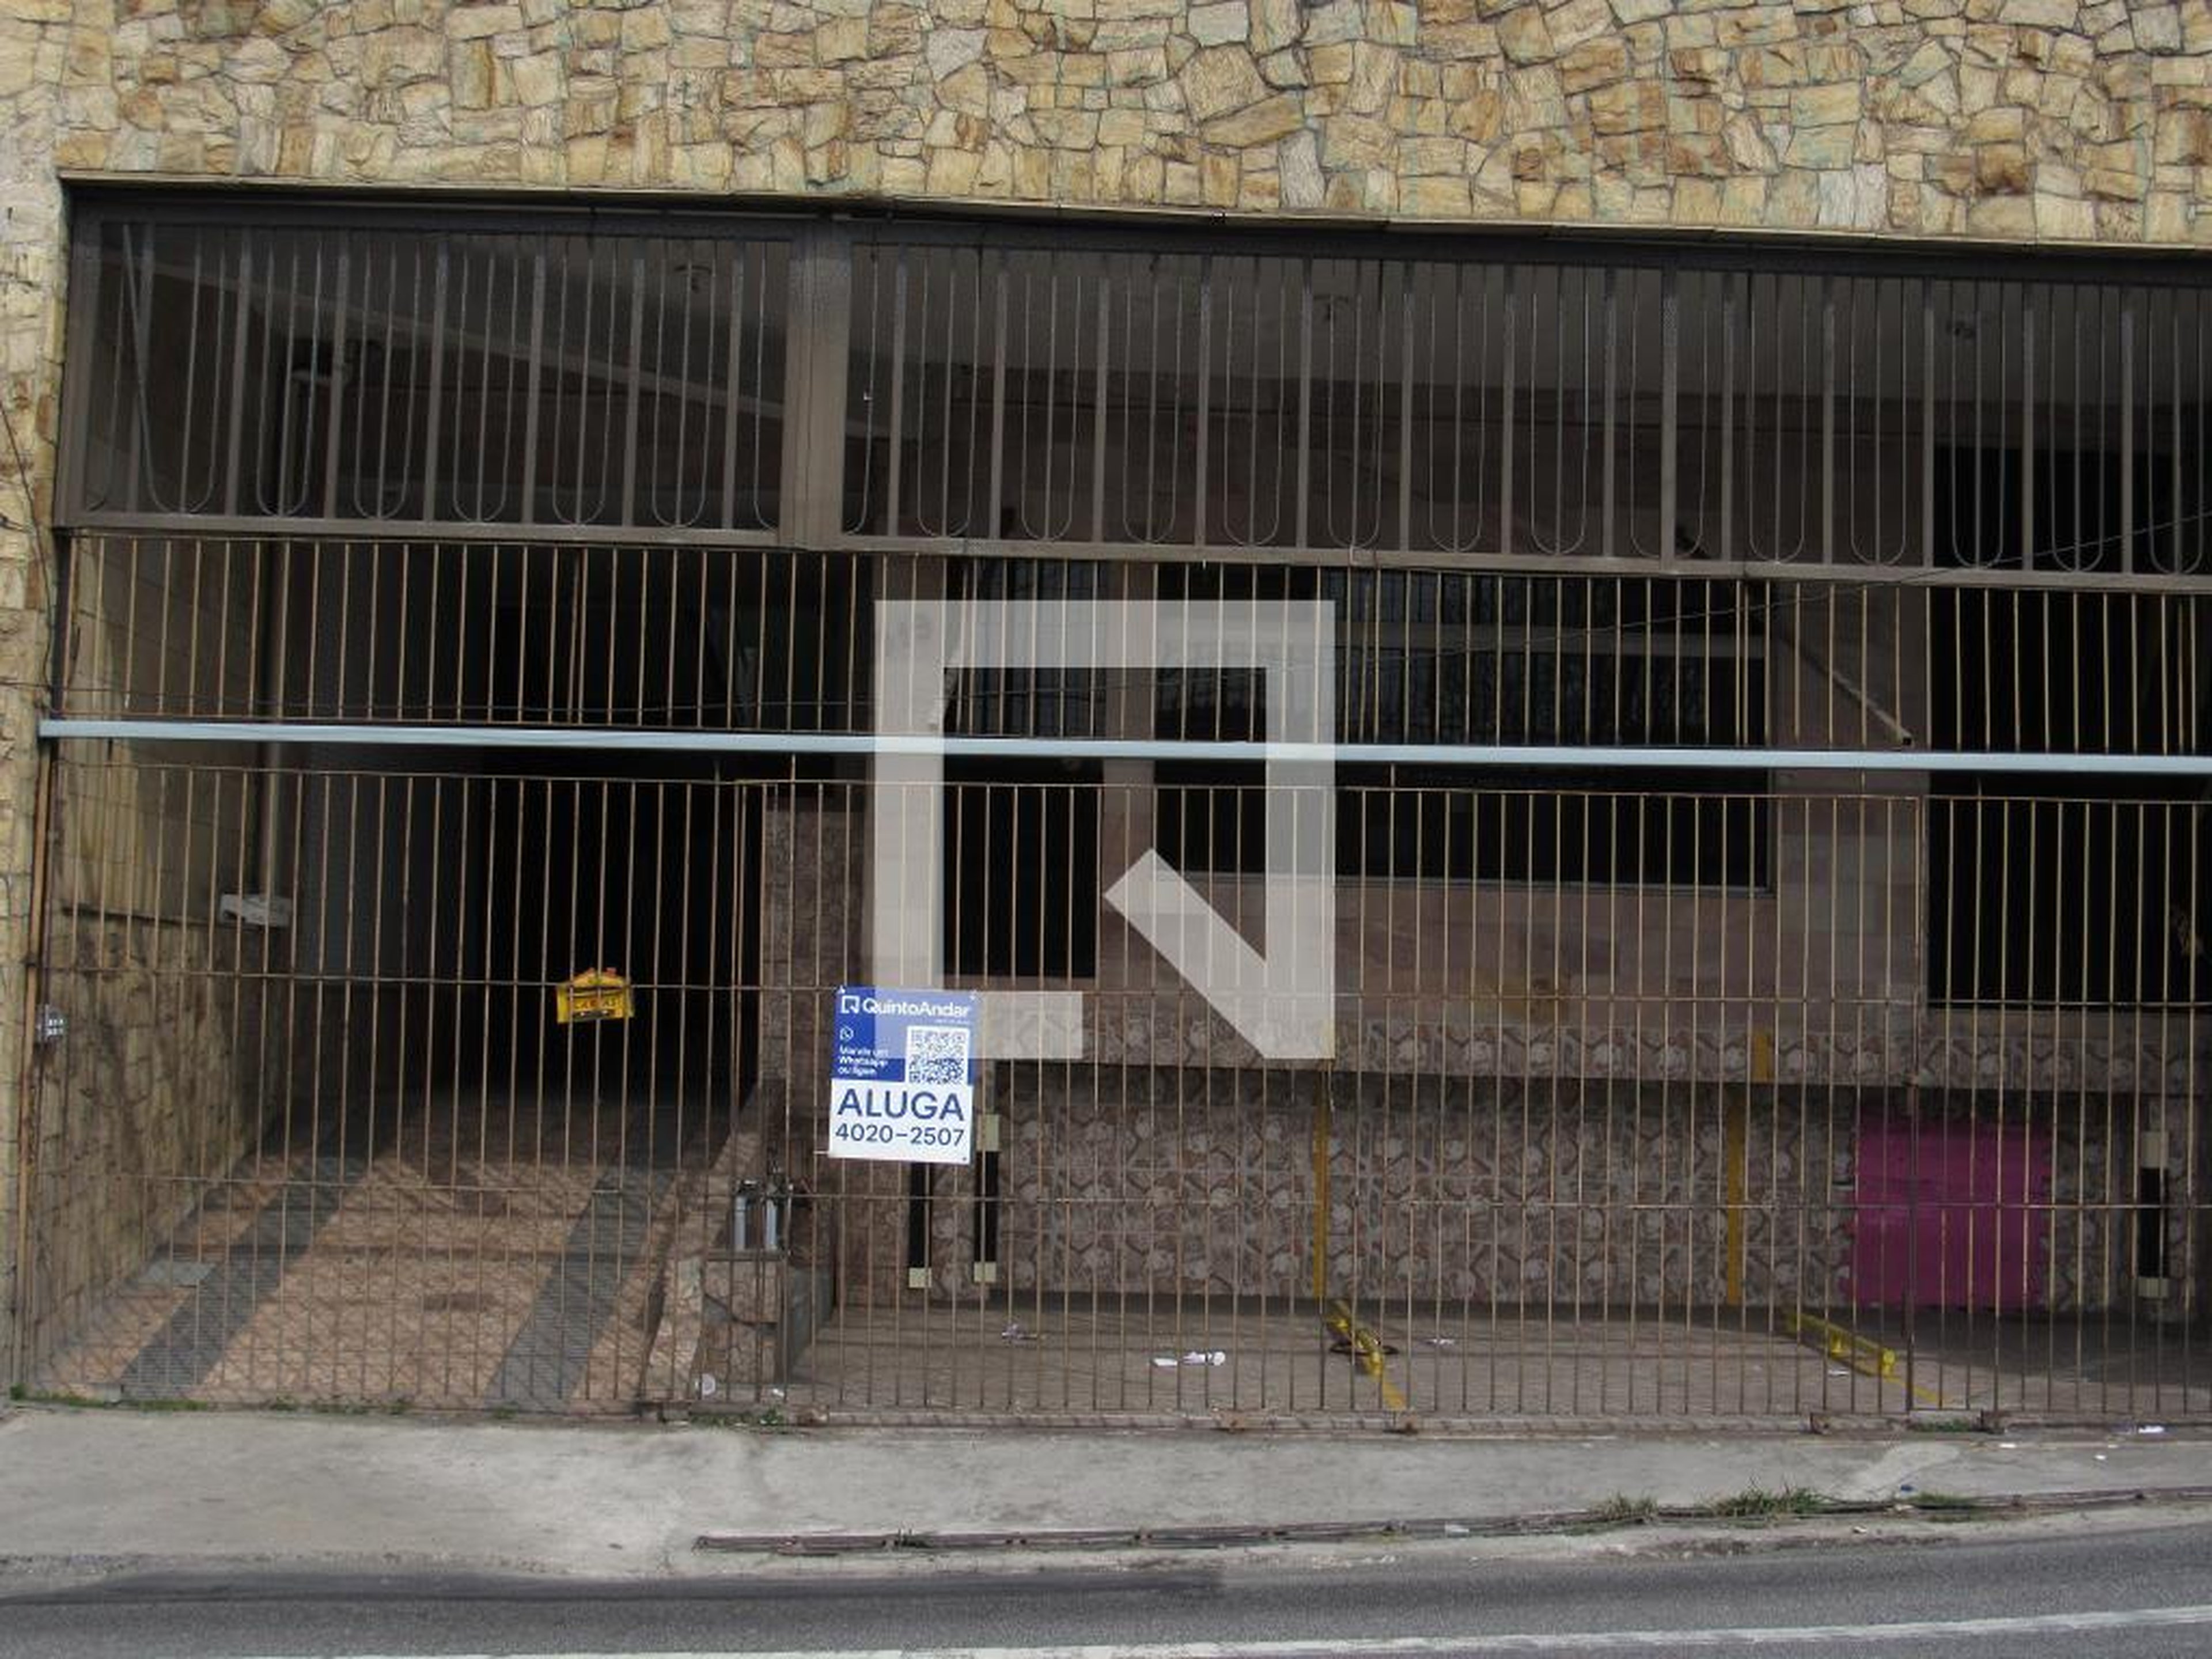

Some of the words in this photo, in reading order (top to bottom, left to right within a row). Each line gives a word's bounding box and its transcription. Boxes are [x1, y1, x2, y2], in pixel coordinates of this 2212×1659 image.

[863, 997, 969, 1018] QuintoAndar
[837, 1088, 964, 1122] ALUGA
[835, 1123, 964, 1147] 4020-2507
